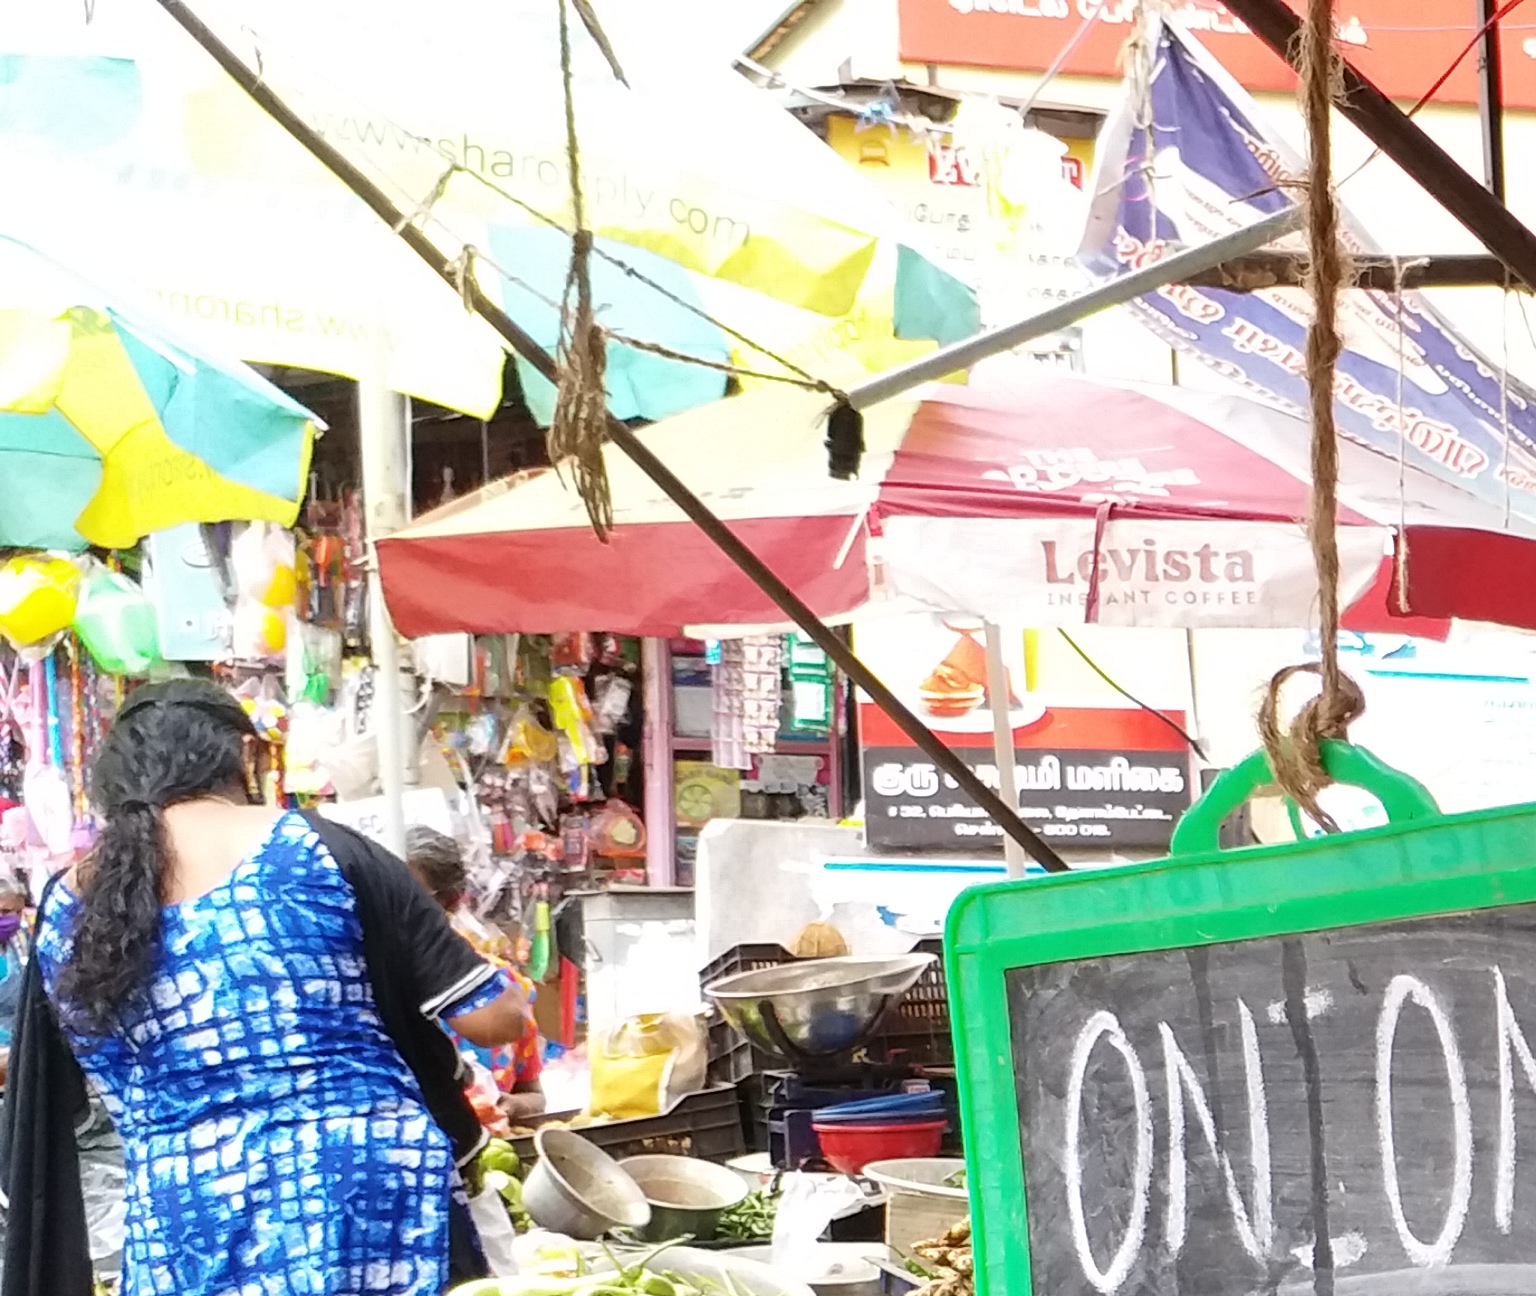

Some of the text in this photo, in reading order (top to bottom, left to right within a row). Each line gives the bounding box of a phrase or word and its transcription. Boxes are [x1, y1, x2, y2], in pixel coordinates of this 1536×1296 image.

[1041, 538, 1256, 585] Levista
[1047, 589, 1258, 606] INSANT COFFEE
[873, 763, 940, 797] குரு
[1066, 756, 1185, 793] மளிகை
